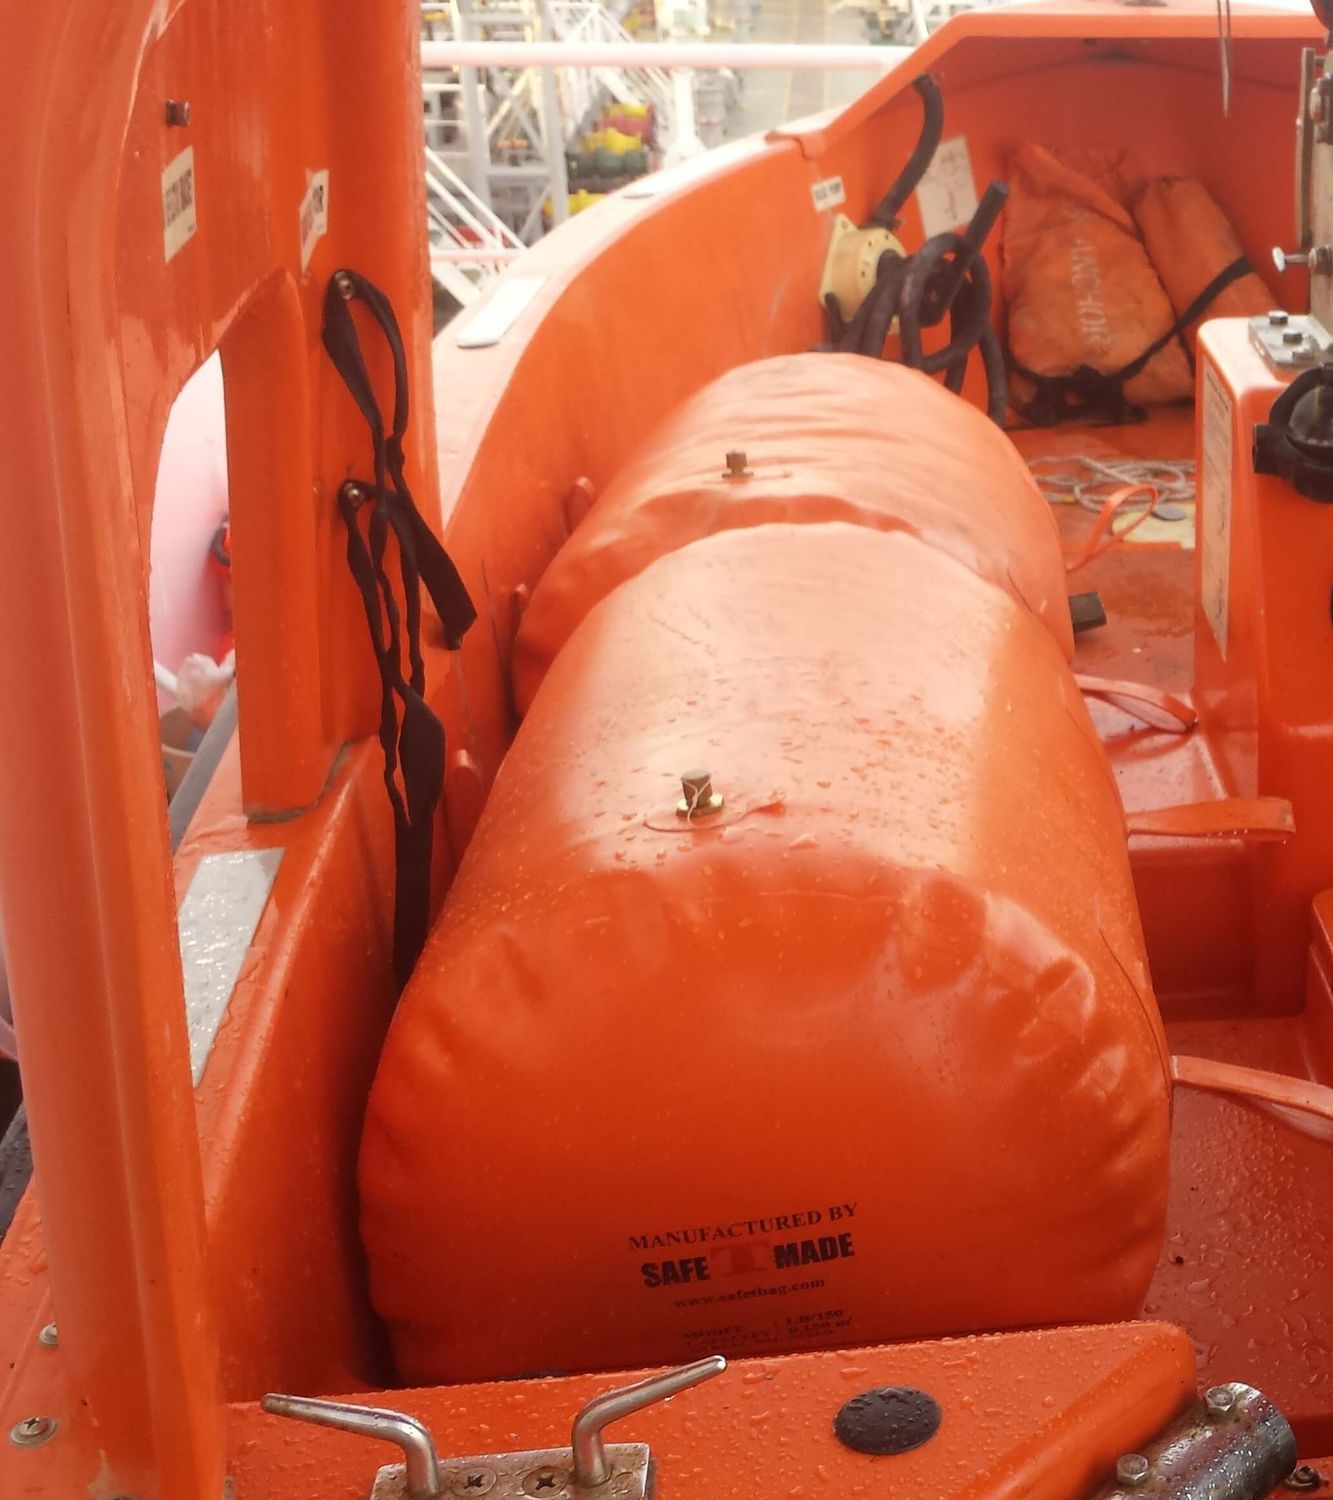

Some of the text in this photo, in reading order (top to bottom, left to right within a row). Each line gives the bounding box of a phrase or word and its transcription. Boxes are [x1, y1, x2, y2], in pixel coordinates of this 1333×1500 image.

[629, 1202, 858, 1250] MANUFACTURED BY
[641, 1256, 711, 1288] SAFE
[773, 1232, 855, 1269] MADE
[674, 1278, 825, 1308] www.safetbag.com
